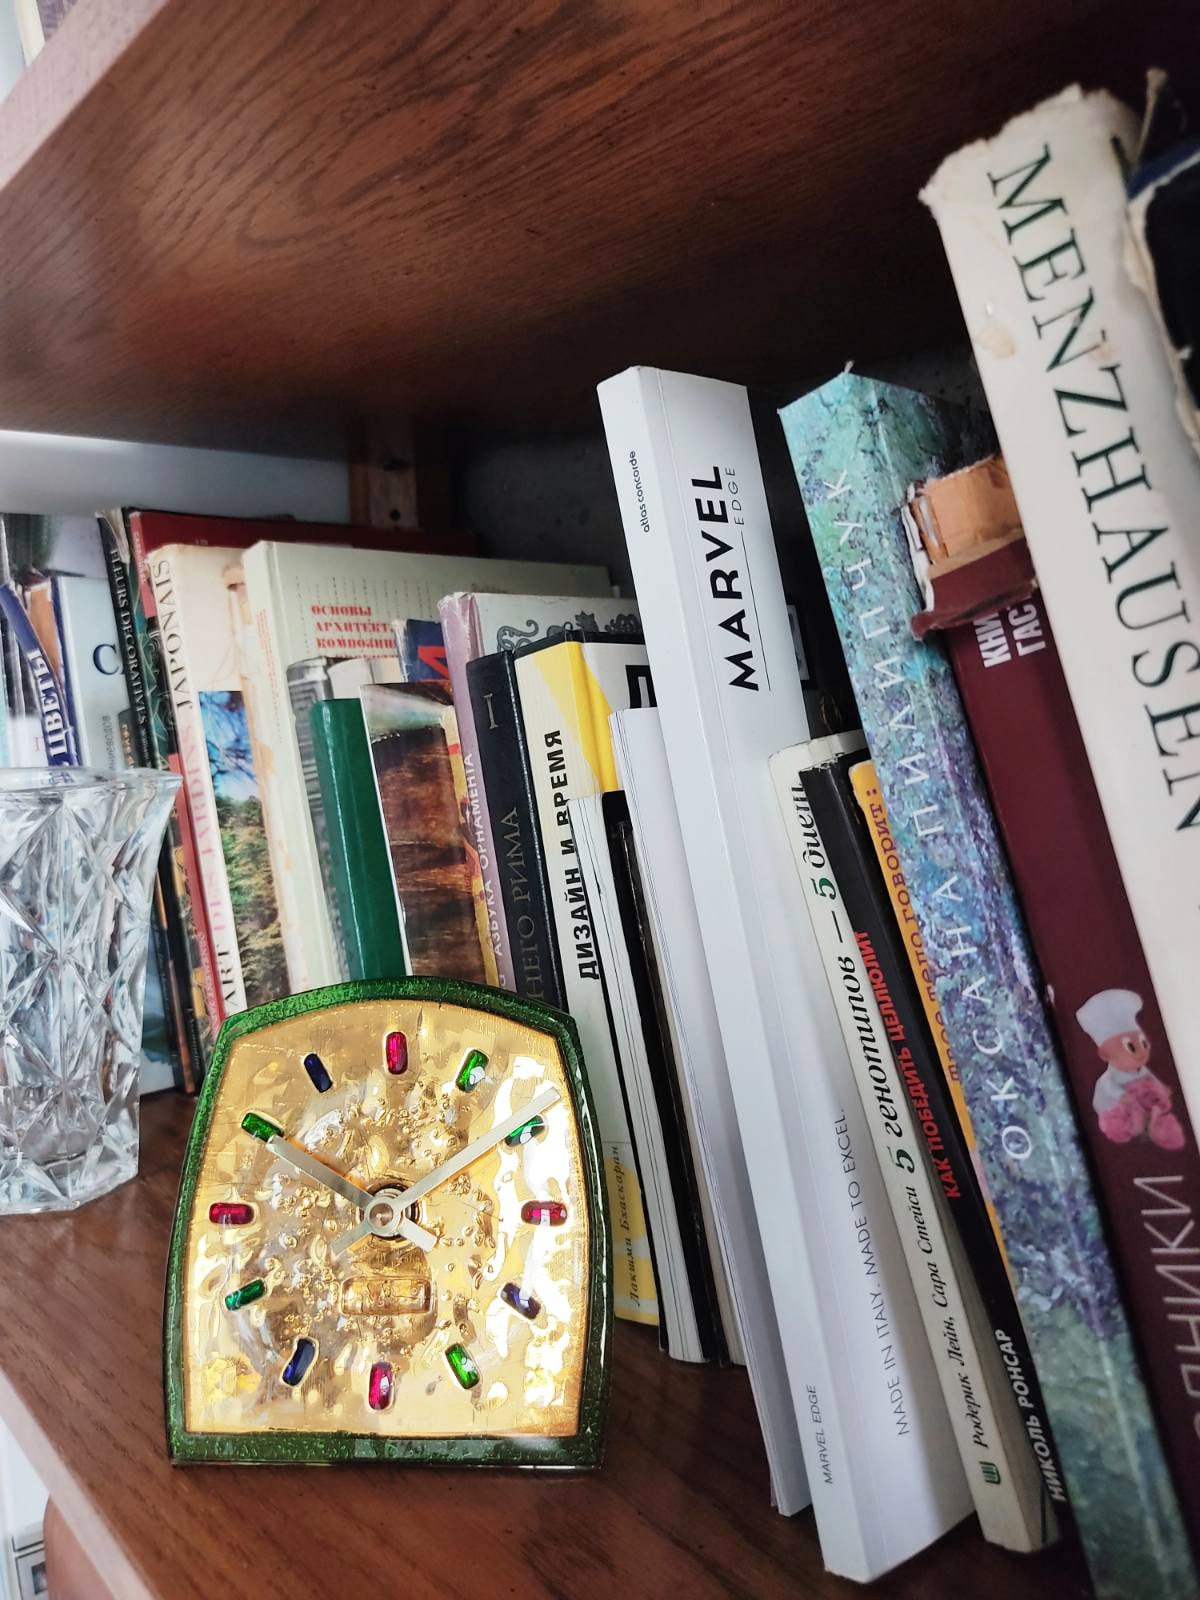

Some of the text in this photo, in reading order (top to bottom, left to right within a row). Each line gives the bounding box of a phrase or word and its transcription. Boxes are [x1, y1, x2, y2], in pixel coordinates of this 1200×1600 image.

[628, 450, 651, 533] atlas concorde
[724, 467, 745, 525] EDGE
[109, 548, 129, 614] FLEURS
[311, 604, 372, 617] ОСНОВЫ
[691, 465, 760, 692] MARVEL
[154, 560, 194, 709] JAPONAIS
[973, 611, 1012, 668] КНИ
[1008, 603, 1047, 657] ГАС
[824, 467, 1034, 1161] ОКСАНА ПИЛИПЧУК
[544, 729, 601, 980] ДИЗАЙН И ВРЕМЯ
[811, 877, 837, 900] 5
[485, 879, 503, 957] АЗБУКА
[500, 806, 545, 1000] НЕГО РИМА
[838, 956, 903, 1139] генотипов
[853, 930, 961, 1199] КАК ПОБЕДИТЬ ЦЕЛЛЮЛИТ
[849, 1180, 862, 1211] TO
[890, 1147, 917, 1174] 5
[611, 1146, 641, 1307] Лакшми Бхаскаран
[857, 1213, 880, 1275] MADE
[903, 1185, 934, 1255] Стейси
[926, 1261, 949, 1308] Сара
[1133, 1175, 1200, 1441] НИКИ
[883, 1345, 896, 1370] IN
[806, 1384, 834, 1484] MARVEL EDGE
[887, 1373, 910, 1435] MADE
[958, 1371, 989, 1449] Родерик
[995, 1329, 1067, 1502] НИКОЛЬ РОНСАР
